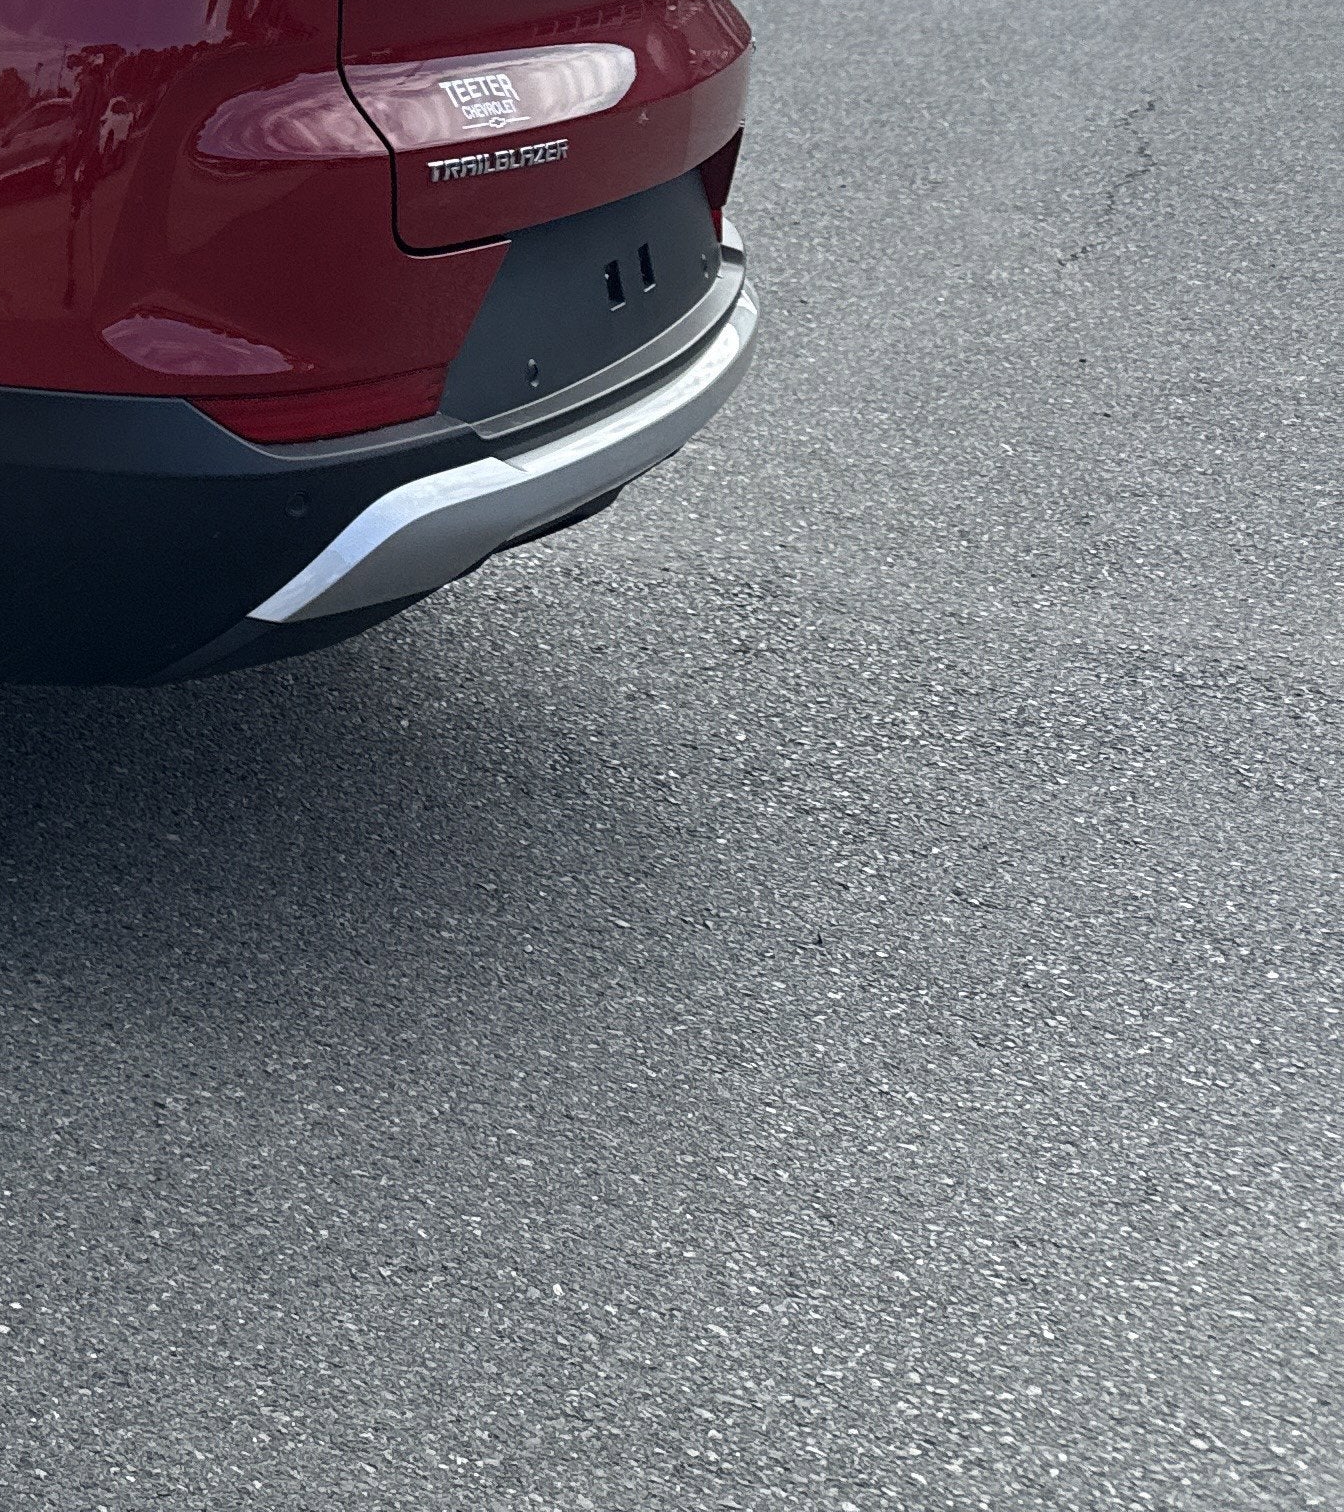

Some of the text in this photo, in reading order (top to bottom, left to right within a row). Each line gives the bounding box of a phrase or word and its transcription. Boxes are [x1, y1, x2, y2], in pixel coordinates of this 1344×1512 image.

[439, 73, 520, 108] TEETER
[462, 99, 516, 120] CHEVROLET
[427, 139, 569, 182] TRAILBLAZER
